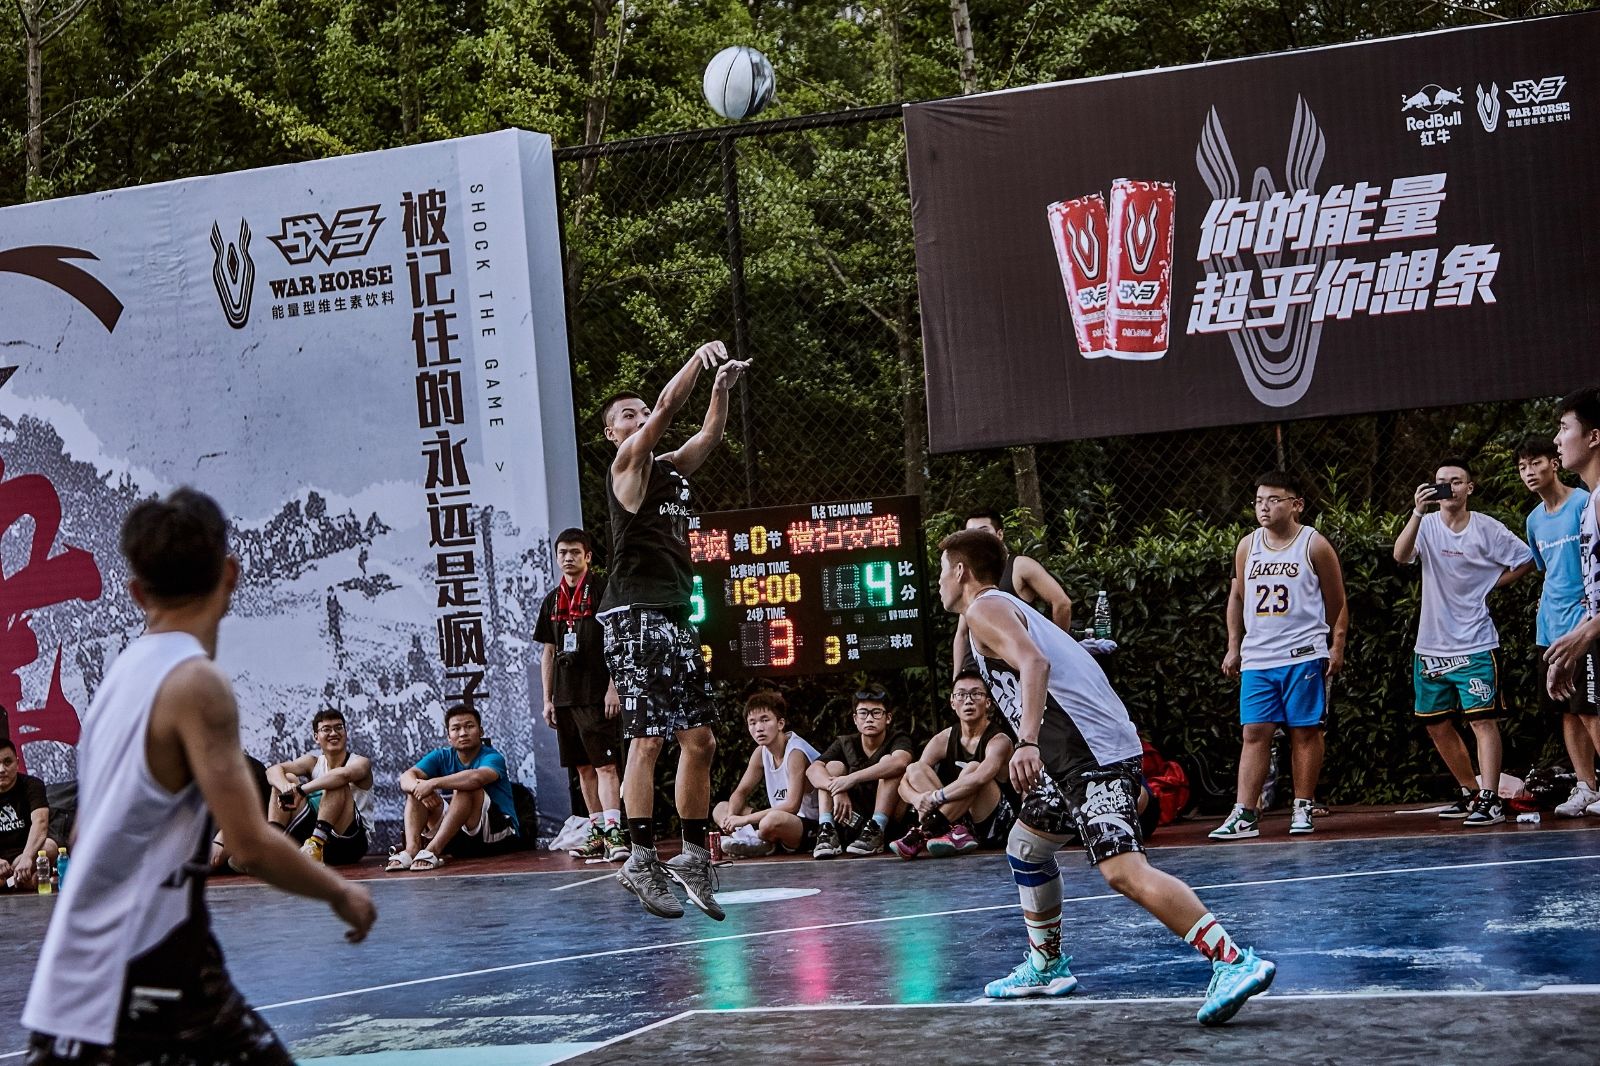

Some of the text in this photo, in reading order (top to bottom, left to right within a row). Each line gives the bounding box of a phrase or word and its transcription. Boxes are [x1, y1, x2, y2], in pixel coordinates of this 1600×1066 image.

[1405, 112, 1462, 132] RedBull
[1506, 102, 1571, 119] WAR HORSE
[1420, 128, 1451, 147] 红牛
[1196, 172, 1449, 262] 你的能量
[269, 265, 394, 300] WAR HORSE
[1186, 242, 1502, 335] 超乎你想象
[272, 291, 395, 321] 能量型维生素饮料
[469, 183, 505, 428] SHOCK THE GAME
[400, 188, 489, 709] 被记住的永远是疯子
[827, 504, 849, 518] TEAM
[850, 501, 874, 516] NAME
[730, 561, 790, 579] 比赛时间 TIME
[1248, 560, 1300, 580] LAKERS
[733, 573, 802, 606] 15:00
[1256, 584, 1290, 617] 23
[766, 606, 787, 620] TIME
[897, 609, 909, 619] TIME
[908, 608, 919, 619] OUT
[769, 618, 796, 667] 3
[824, 635, 842, 665] 3
[889, 633, 914, 649] 球权
